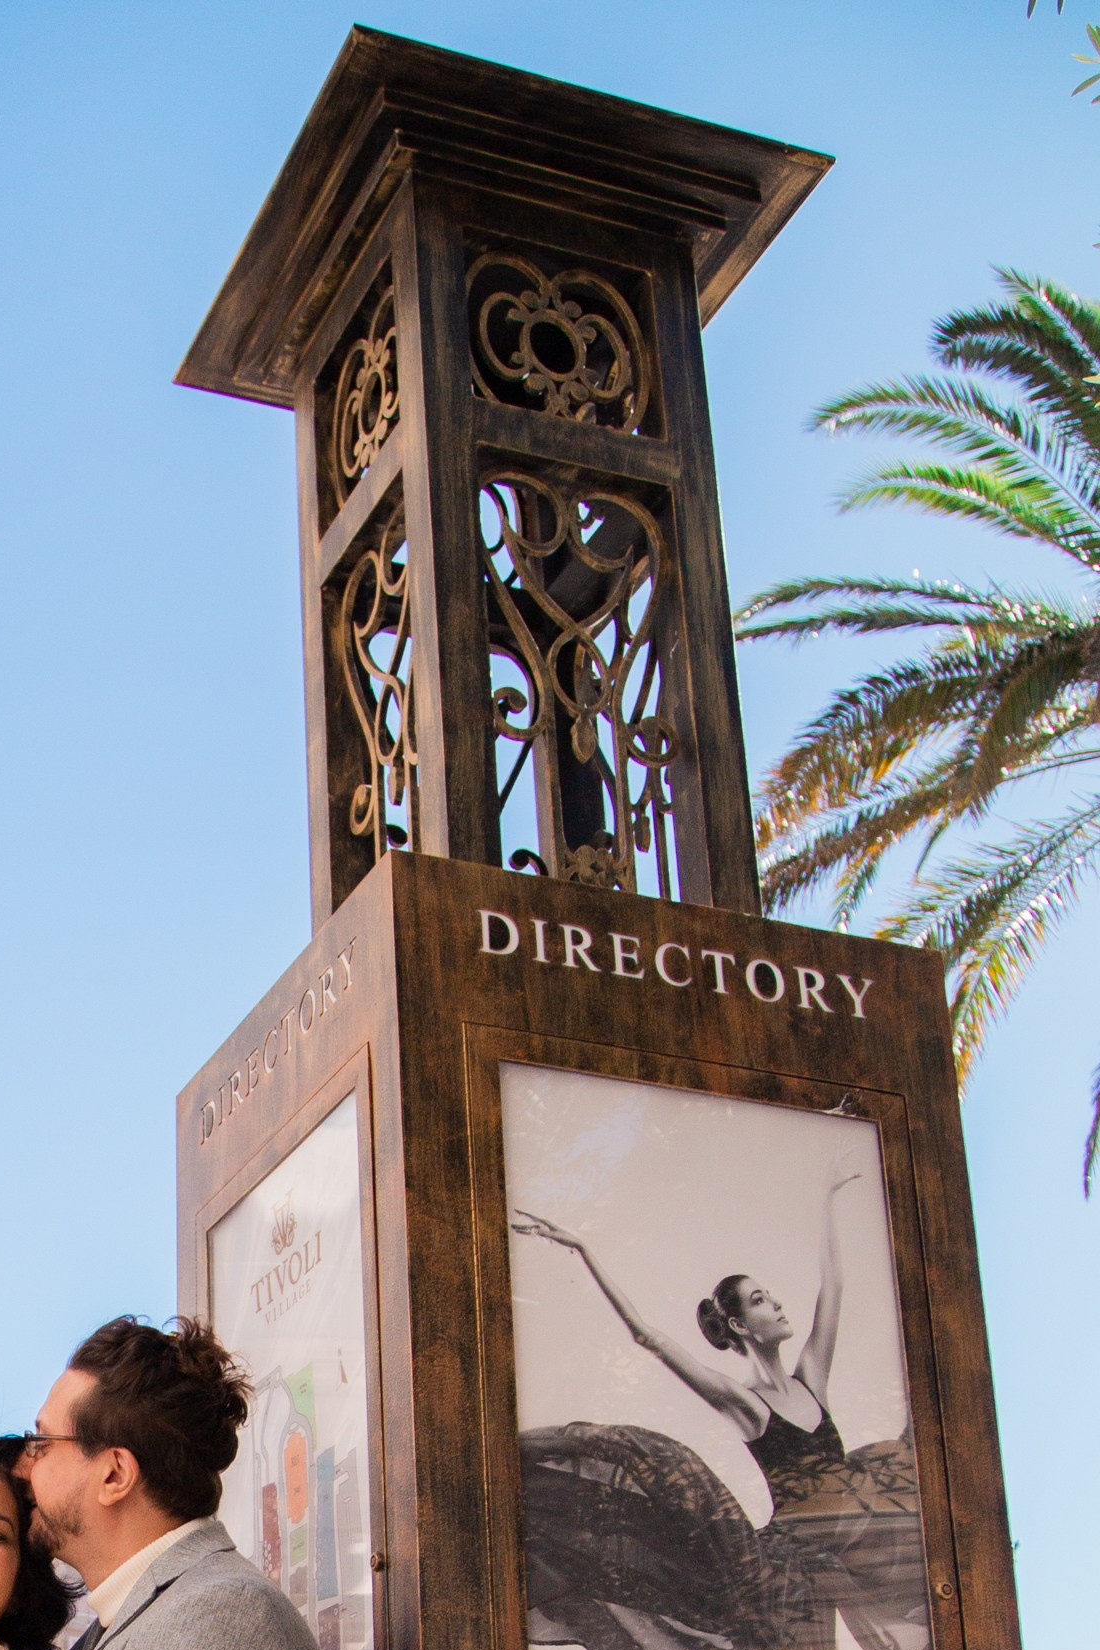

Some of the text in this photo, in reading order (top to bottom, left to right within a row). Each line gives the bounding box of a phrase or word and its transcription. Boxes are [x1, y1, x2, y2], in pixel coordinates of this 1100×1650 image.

[478, 908, 875, 1019] DIRECTORY
[200, 935, 357, 1146] DIRECTORY
[250, 1229, 322, 1314] TIVOLI
[264, 1278, 312, 1326] VILLAGE
